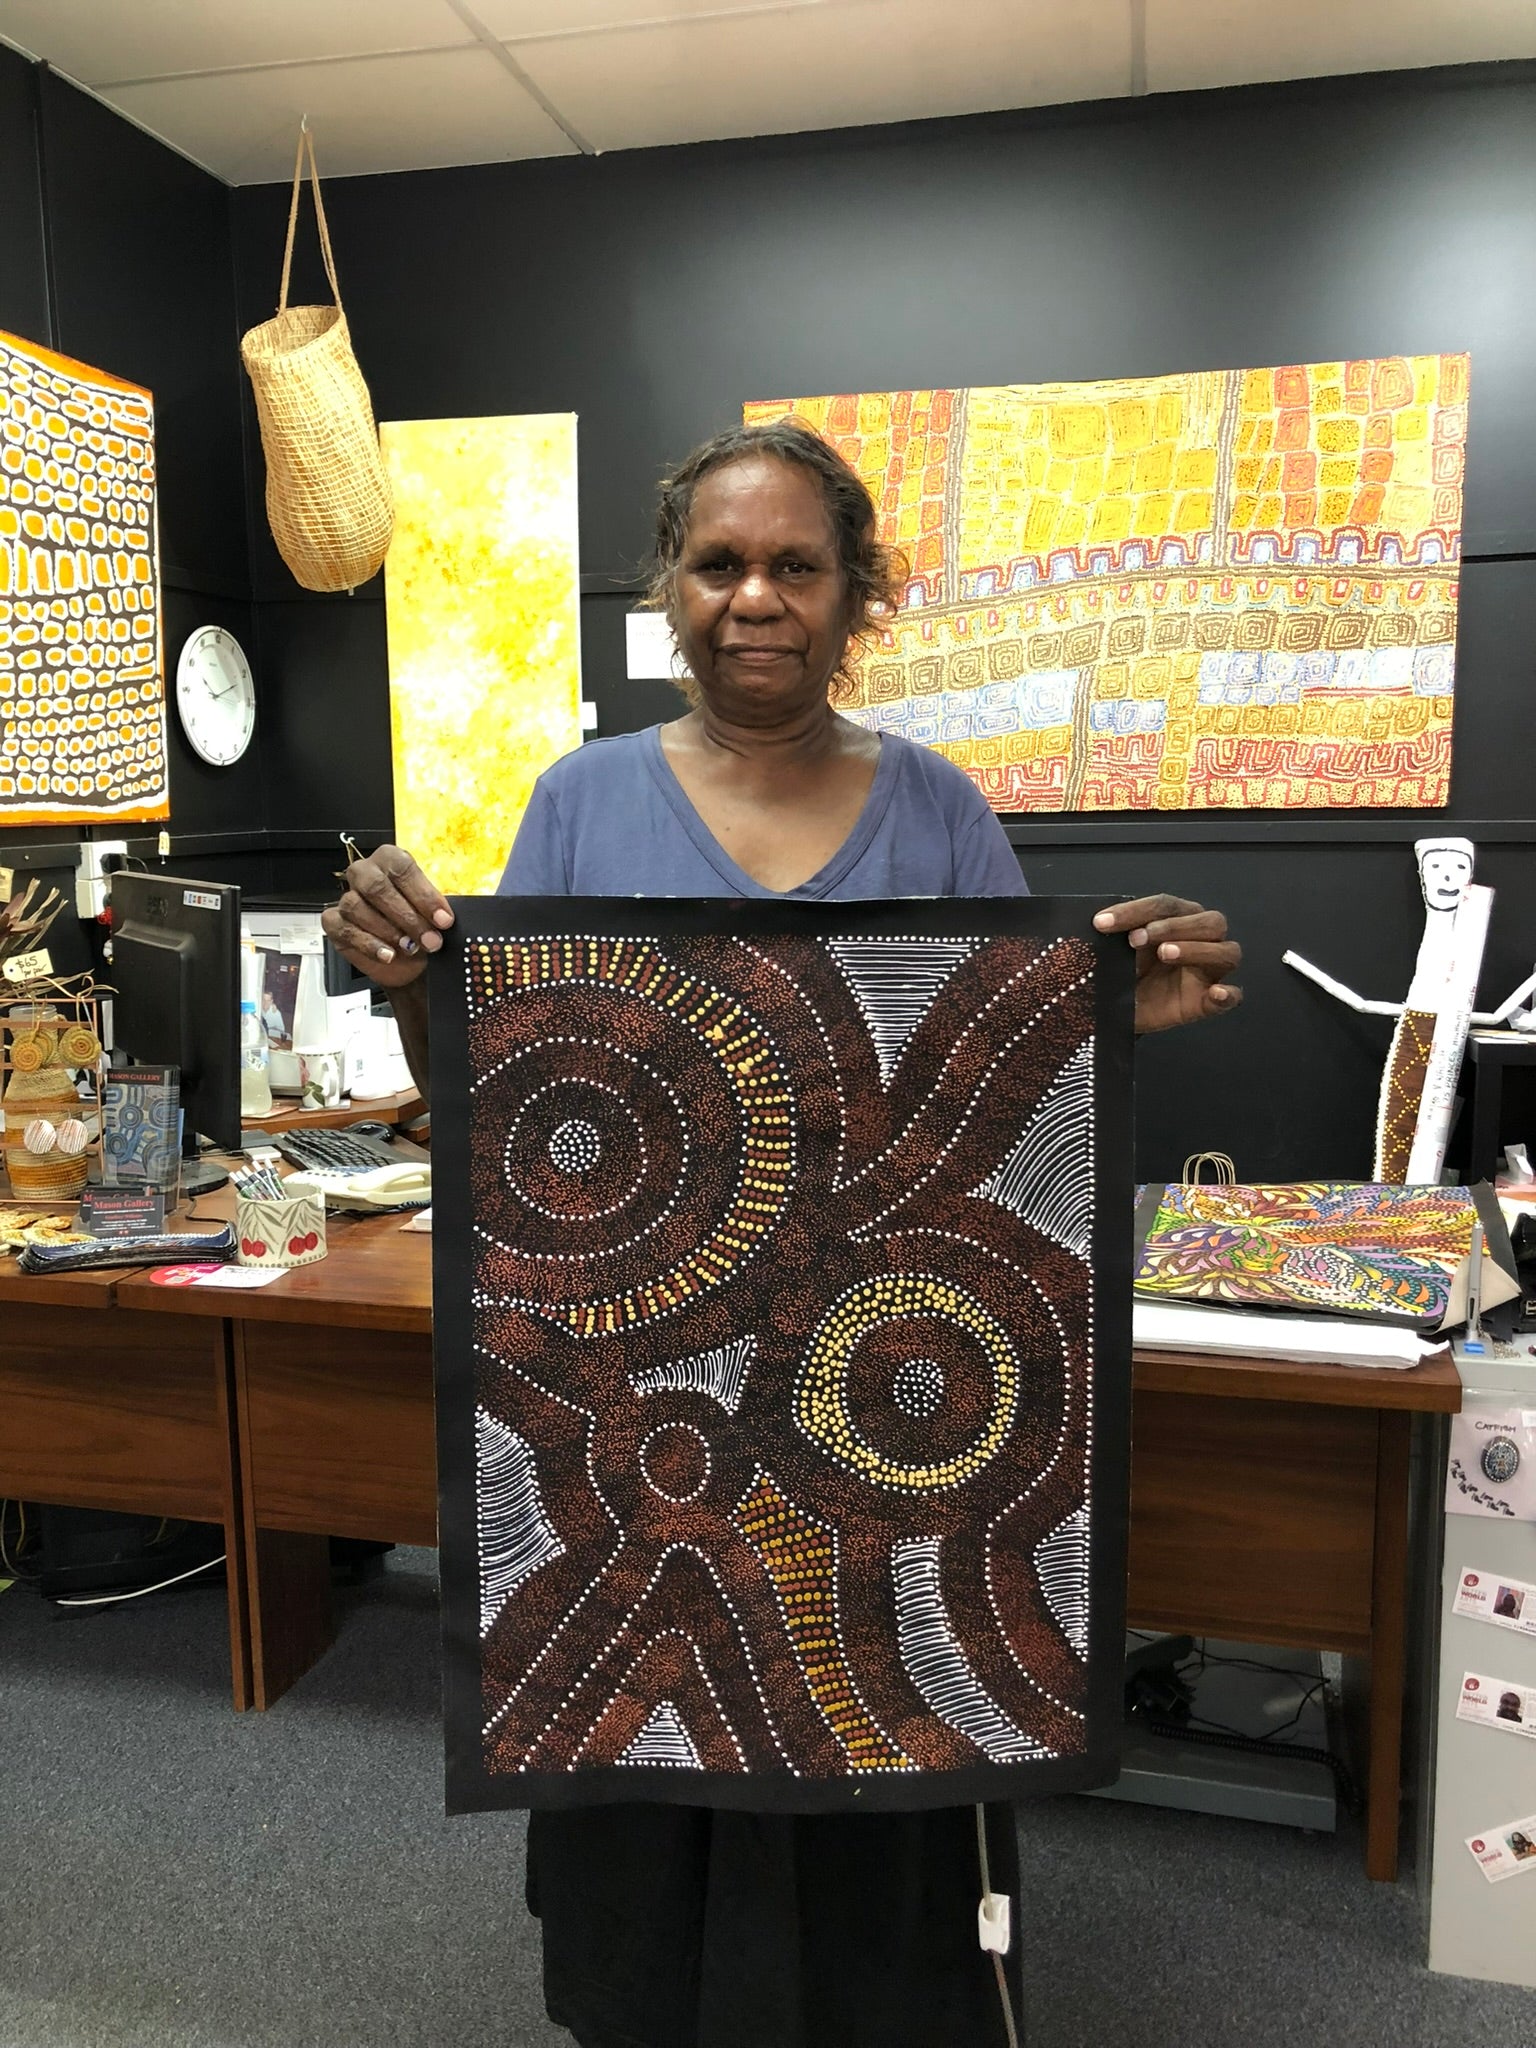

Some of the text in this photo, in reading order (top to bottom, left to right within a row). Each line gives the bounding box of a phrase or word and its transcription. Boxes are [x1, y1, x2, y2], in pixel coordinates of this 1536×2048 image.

[15, 955, 38, 969] $65
[1445, 1051, 1457, 1089] PRINCES
[130, 1073, 160, 1081] GALLERY
[94, 1200, 154, 1209] Mason Gallery
[1475, 1421, 1516, 1433] CATFISH
[1461, 1591, 1486, 1601] WORLD
